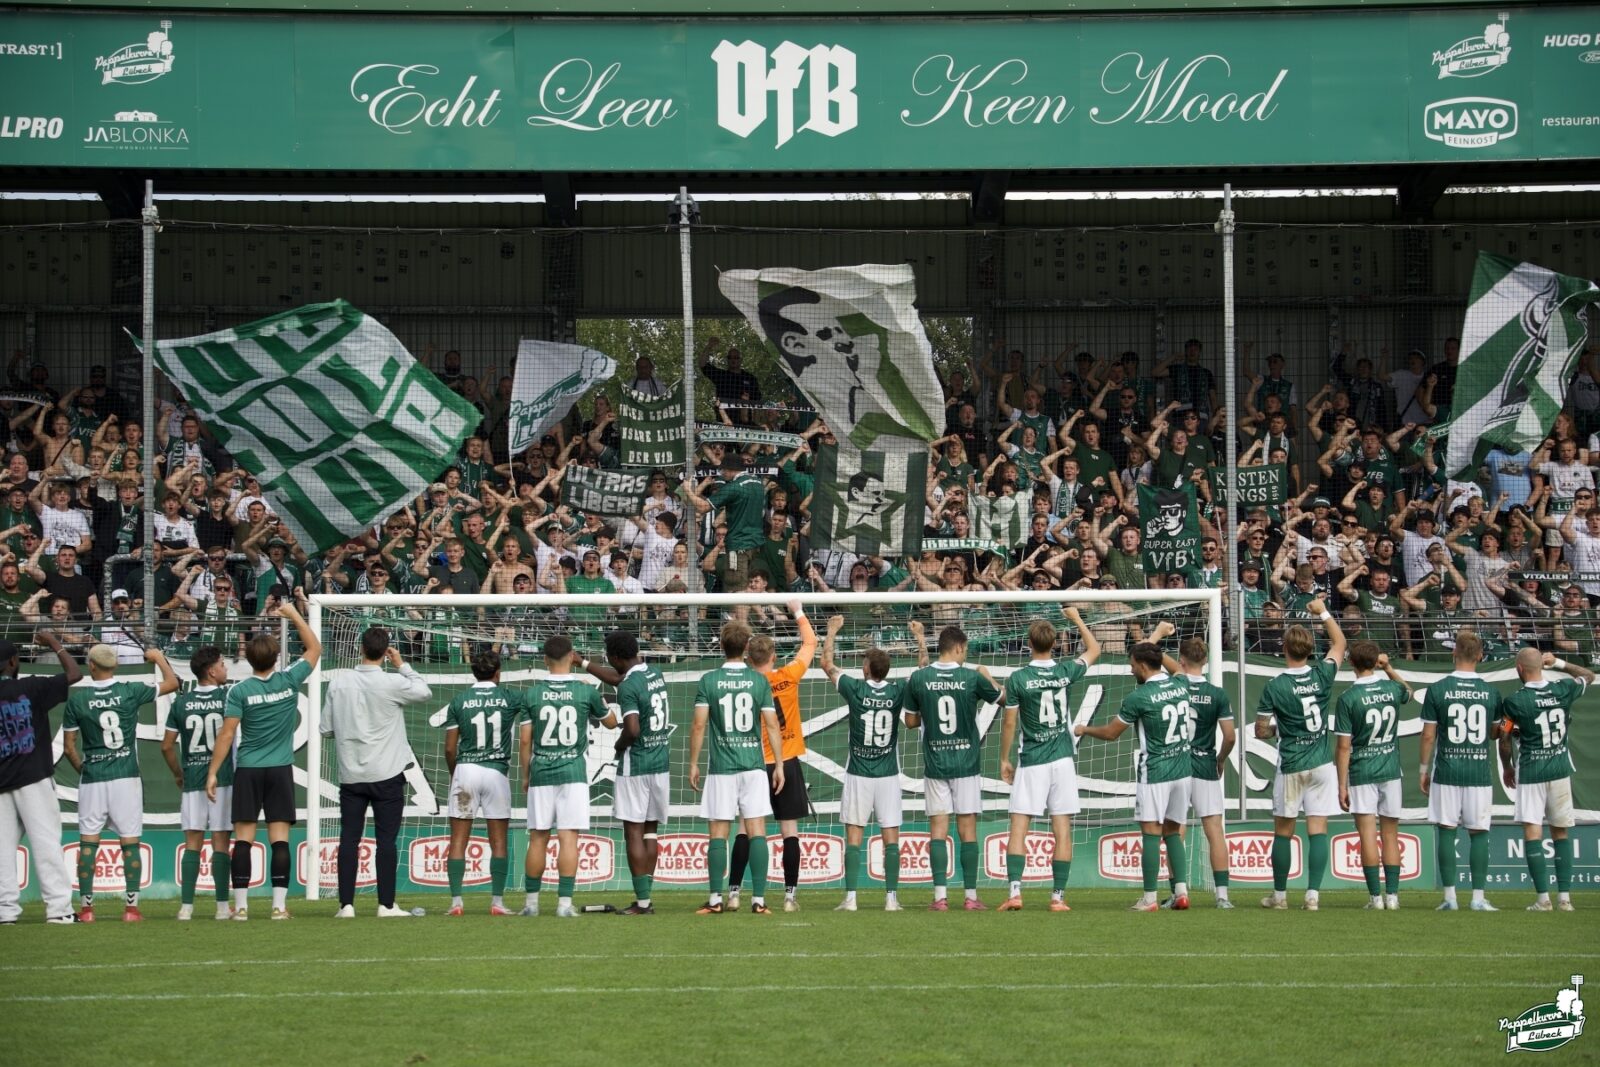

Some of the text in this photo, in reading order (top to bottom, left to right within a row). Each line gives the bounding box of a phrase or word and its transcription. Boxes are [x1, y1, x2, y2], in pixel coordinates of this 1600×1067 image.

[1543, 34, 1590, 47] HUGO
[350, 62, 502, 134] Echt
[711, 39, 858, 149] VfB
[900, 53, 1074, 127] Keen
[1089, 51, 1288, 125] Mood
[1434, 108, 1509, 130] MAYO
[84, 127, 189, 143] JABLONKA
[1448, 136, 1494, 145] FEINKOST
[628, 450, 649, 463] DER
[567, 465, 649, 493] ULTRAS
[1216, 469, 1280, 487] KSTEN
[1143, 537, 1198, 549] SUPER EASY
[717, 680, 754, 690] PHILIPP
[925, 681, 966, 691] VERINAC
[1292, 682, 1320, 696] MENKE
[88, 695, 122, 710] POLAT
[462, 698, 508, 709] ABU ALFA
[542, 691, 573, 701] DEMIR
[862, 698, 893, 708] ISTEFO
[1361, 692, 1394, 706] ULRICH
[1444, 691, 1489, 701] ALBRECHT
[1535, 698, 1561, 708] THIEL
[185, 700, 223, 711] SHIVANI
[718, 692, 753, 733] 18
[1039, 688, 1067, 728] 41
[937, 695, 957, 735] 9
[1300, 696, 1322, 732] 5
[99, 710, 124, 750] 8
[471, 711, 502, 750] 11
[539, 705, 578, 747] 28
[860, 709, 893, 748] 19
[1366, 705, 1396, 746] 22
[1447, 703, 1487, 744] 39
[1534, 708, 1567, 749] 13
[185, 712, 225, 753] 20
[424, 843, 483, 860] MAO
[773, 841, 830, 857] MYO
[999, 839, 1056, 855] MYO
[1228, 839, 1273, 855] MAY
[424, 860, 482, 873] LÜBCK
[772, 857, 830, 870] LECK
[999, 855, 1053, 868] LECK
[1113, 855, 1168, 868] LÜBK
[1229, 855, 1273, 868] LÜBEC
[1459, 872, 1510, 883] Fiest
